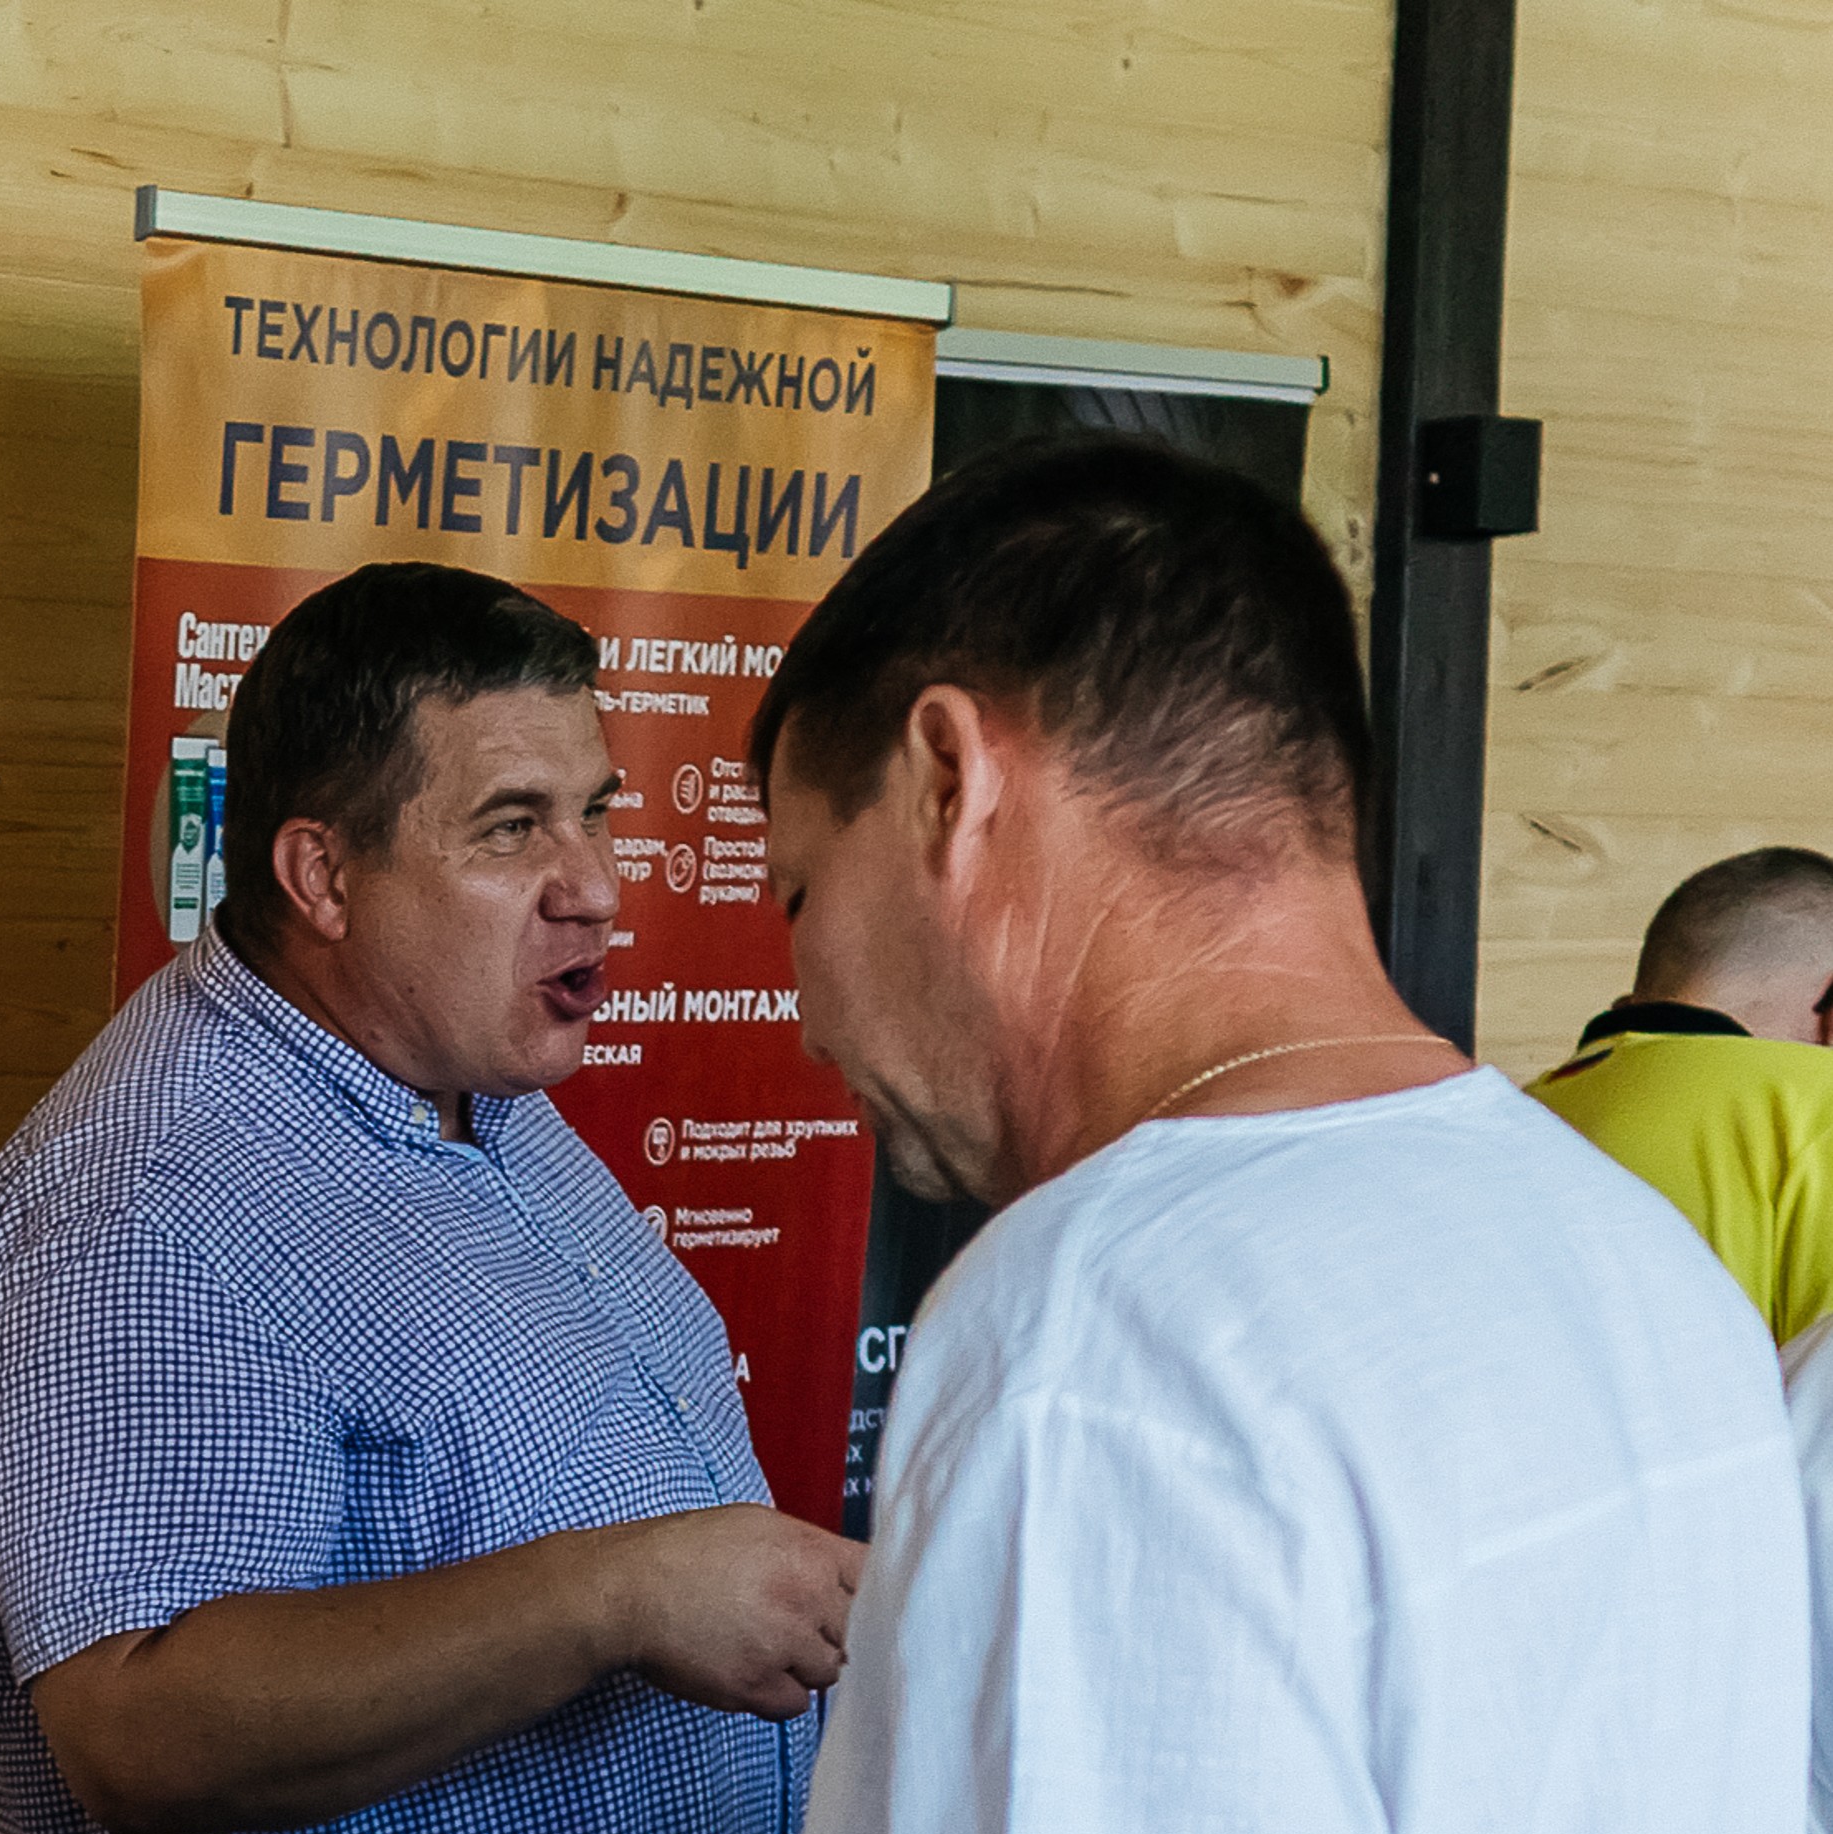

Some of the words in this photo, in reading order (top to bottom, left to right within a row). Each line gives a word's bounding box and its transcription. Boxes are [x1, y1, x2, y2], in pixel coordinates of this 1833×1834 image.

[224, 295, 575, 387] ТЕХНОЛОГИИ
[593, 333, 877, 416] НАДЕЖНОЙ
[219, 421, 862, 569] ГЕРМЕТИЗАЦИИ
[599, 637, 620, 670] И
[625, 635, 739, 677] ЛЕГКИЙ
[592, 982, 678, 1022] ЬНЫЙ
[683, 989, 800, 1022] МОНТАЖ
[582, 1044, 642, 1065] ЕСКАЯ
[750, 1138, 797, 1162] резьб
